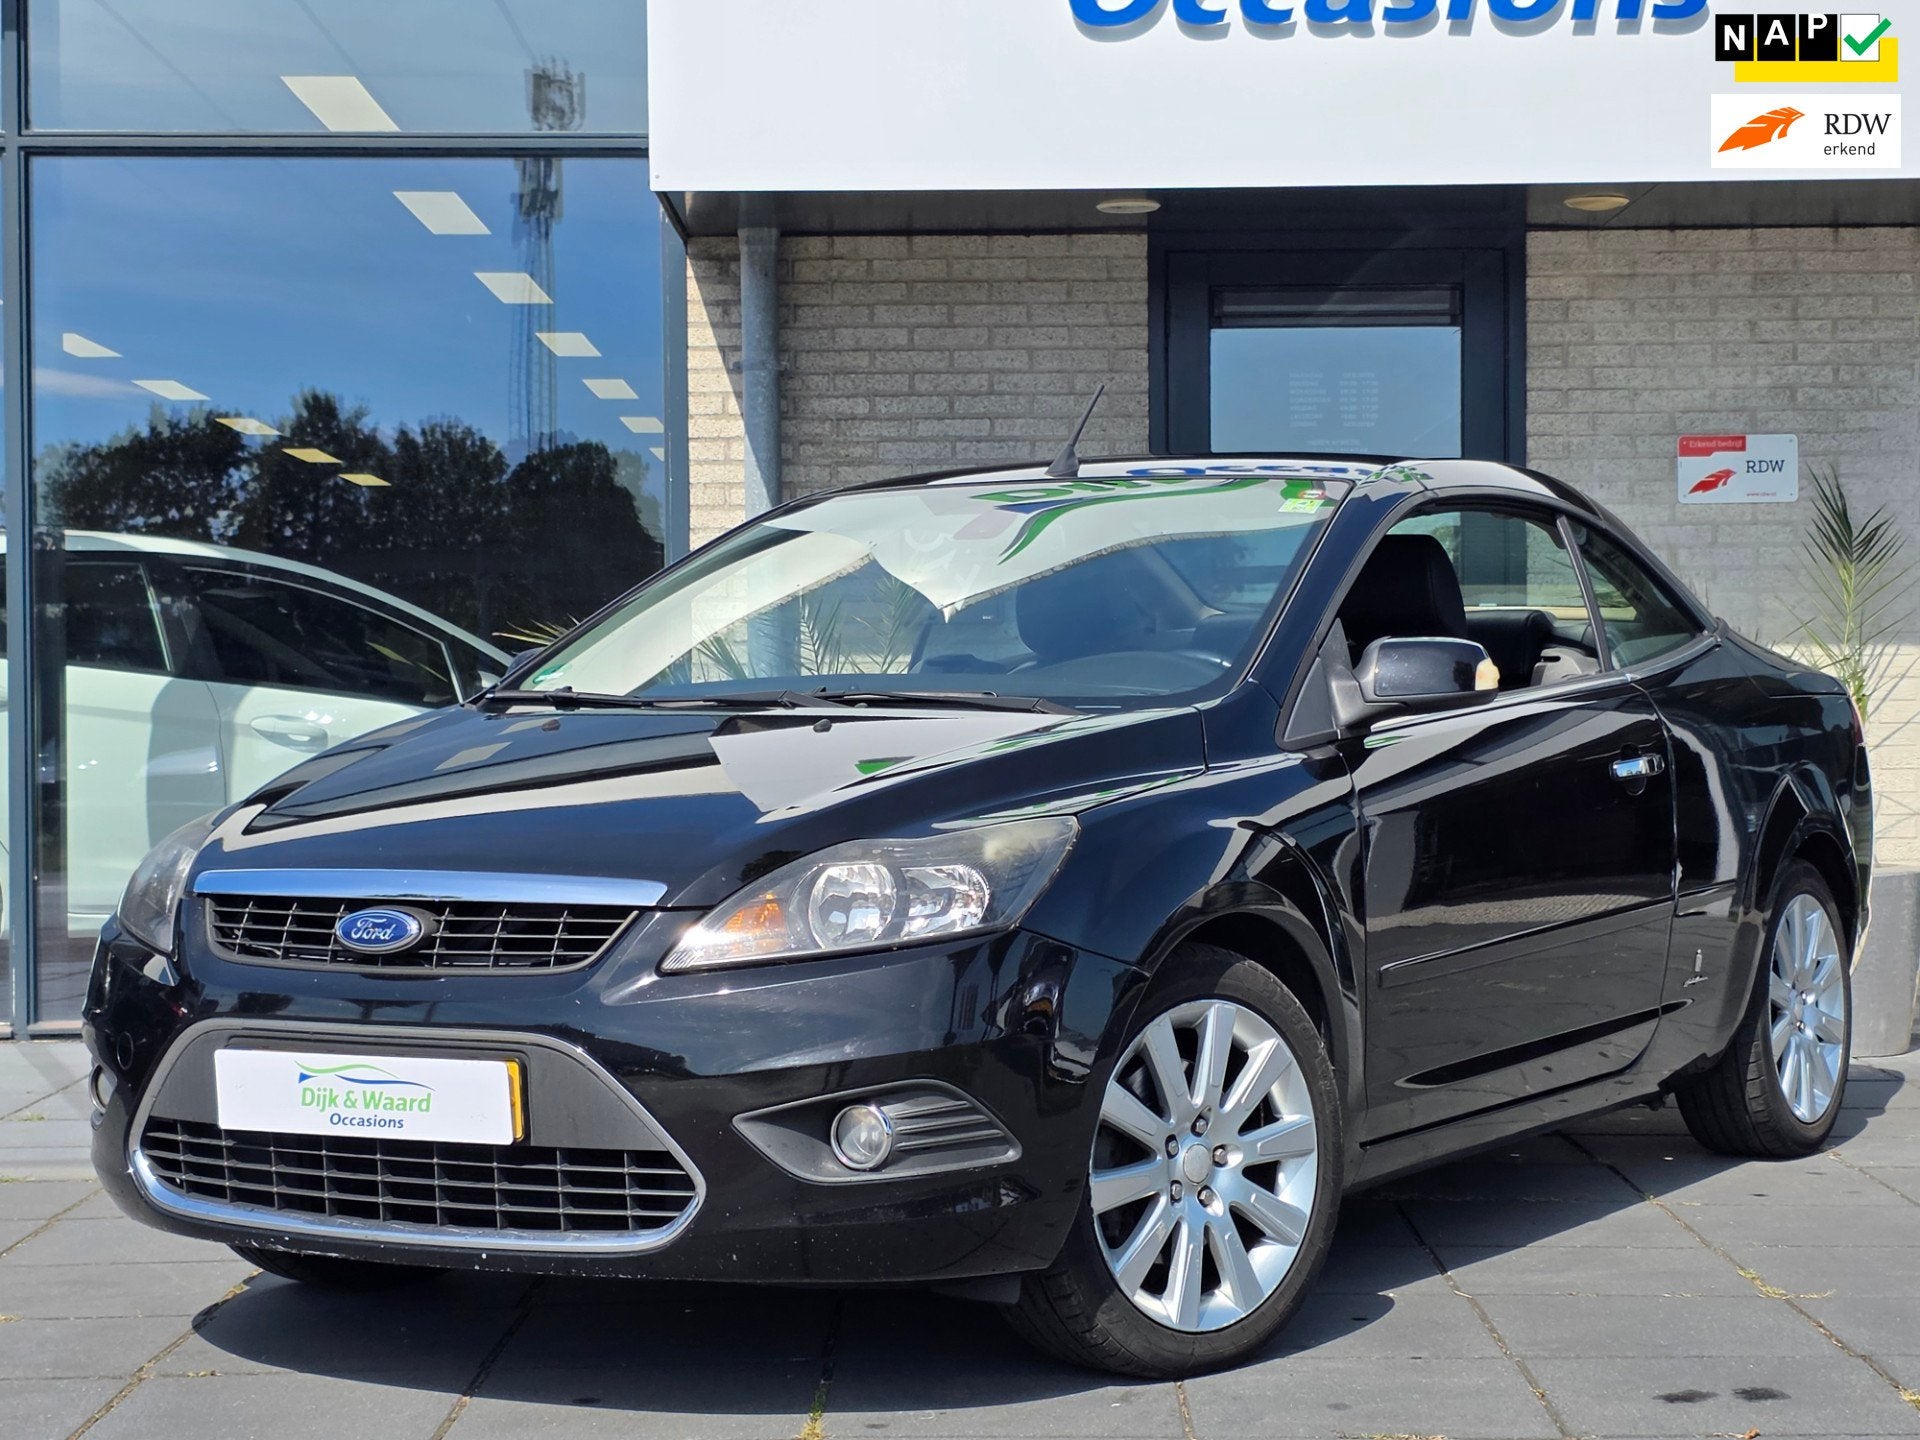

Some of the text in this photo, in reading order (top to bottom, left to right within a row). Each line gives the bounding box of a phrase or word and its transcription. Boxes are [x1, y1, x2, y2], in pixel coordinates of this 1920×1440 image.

[1746, 460, 1785, 473] RDW
[351, 917, 397, 940] Ford
[301, 1087, 431, 1112] Dijk & Waard
[329, 1112, 404, 1129] Occasions
